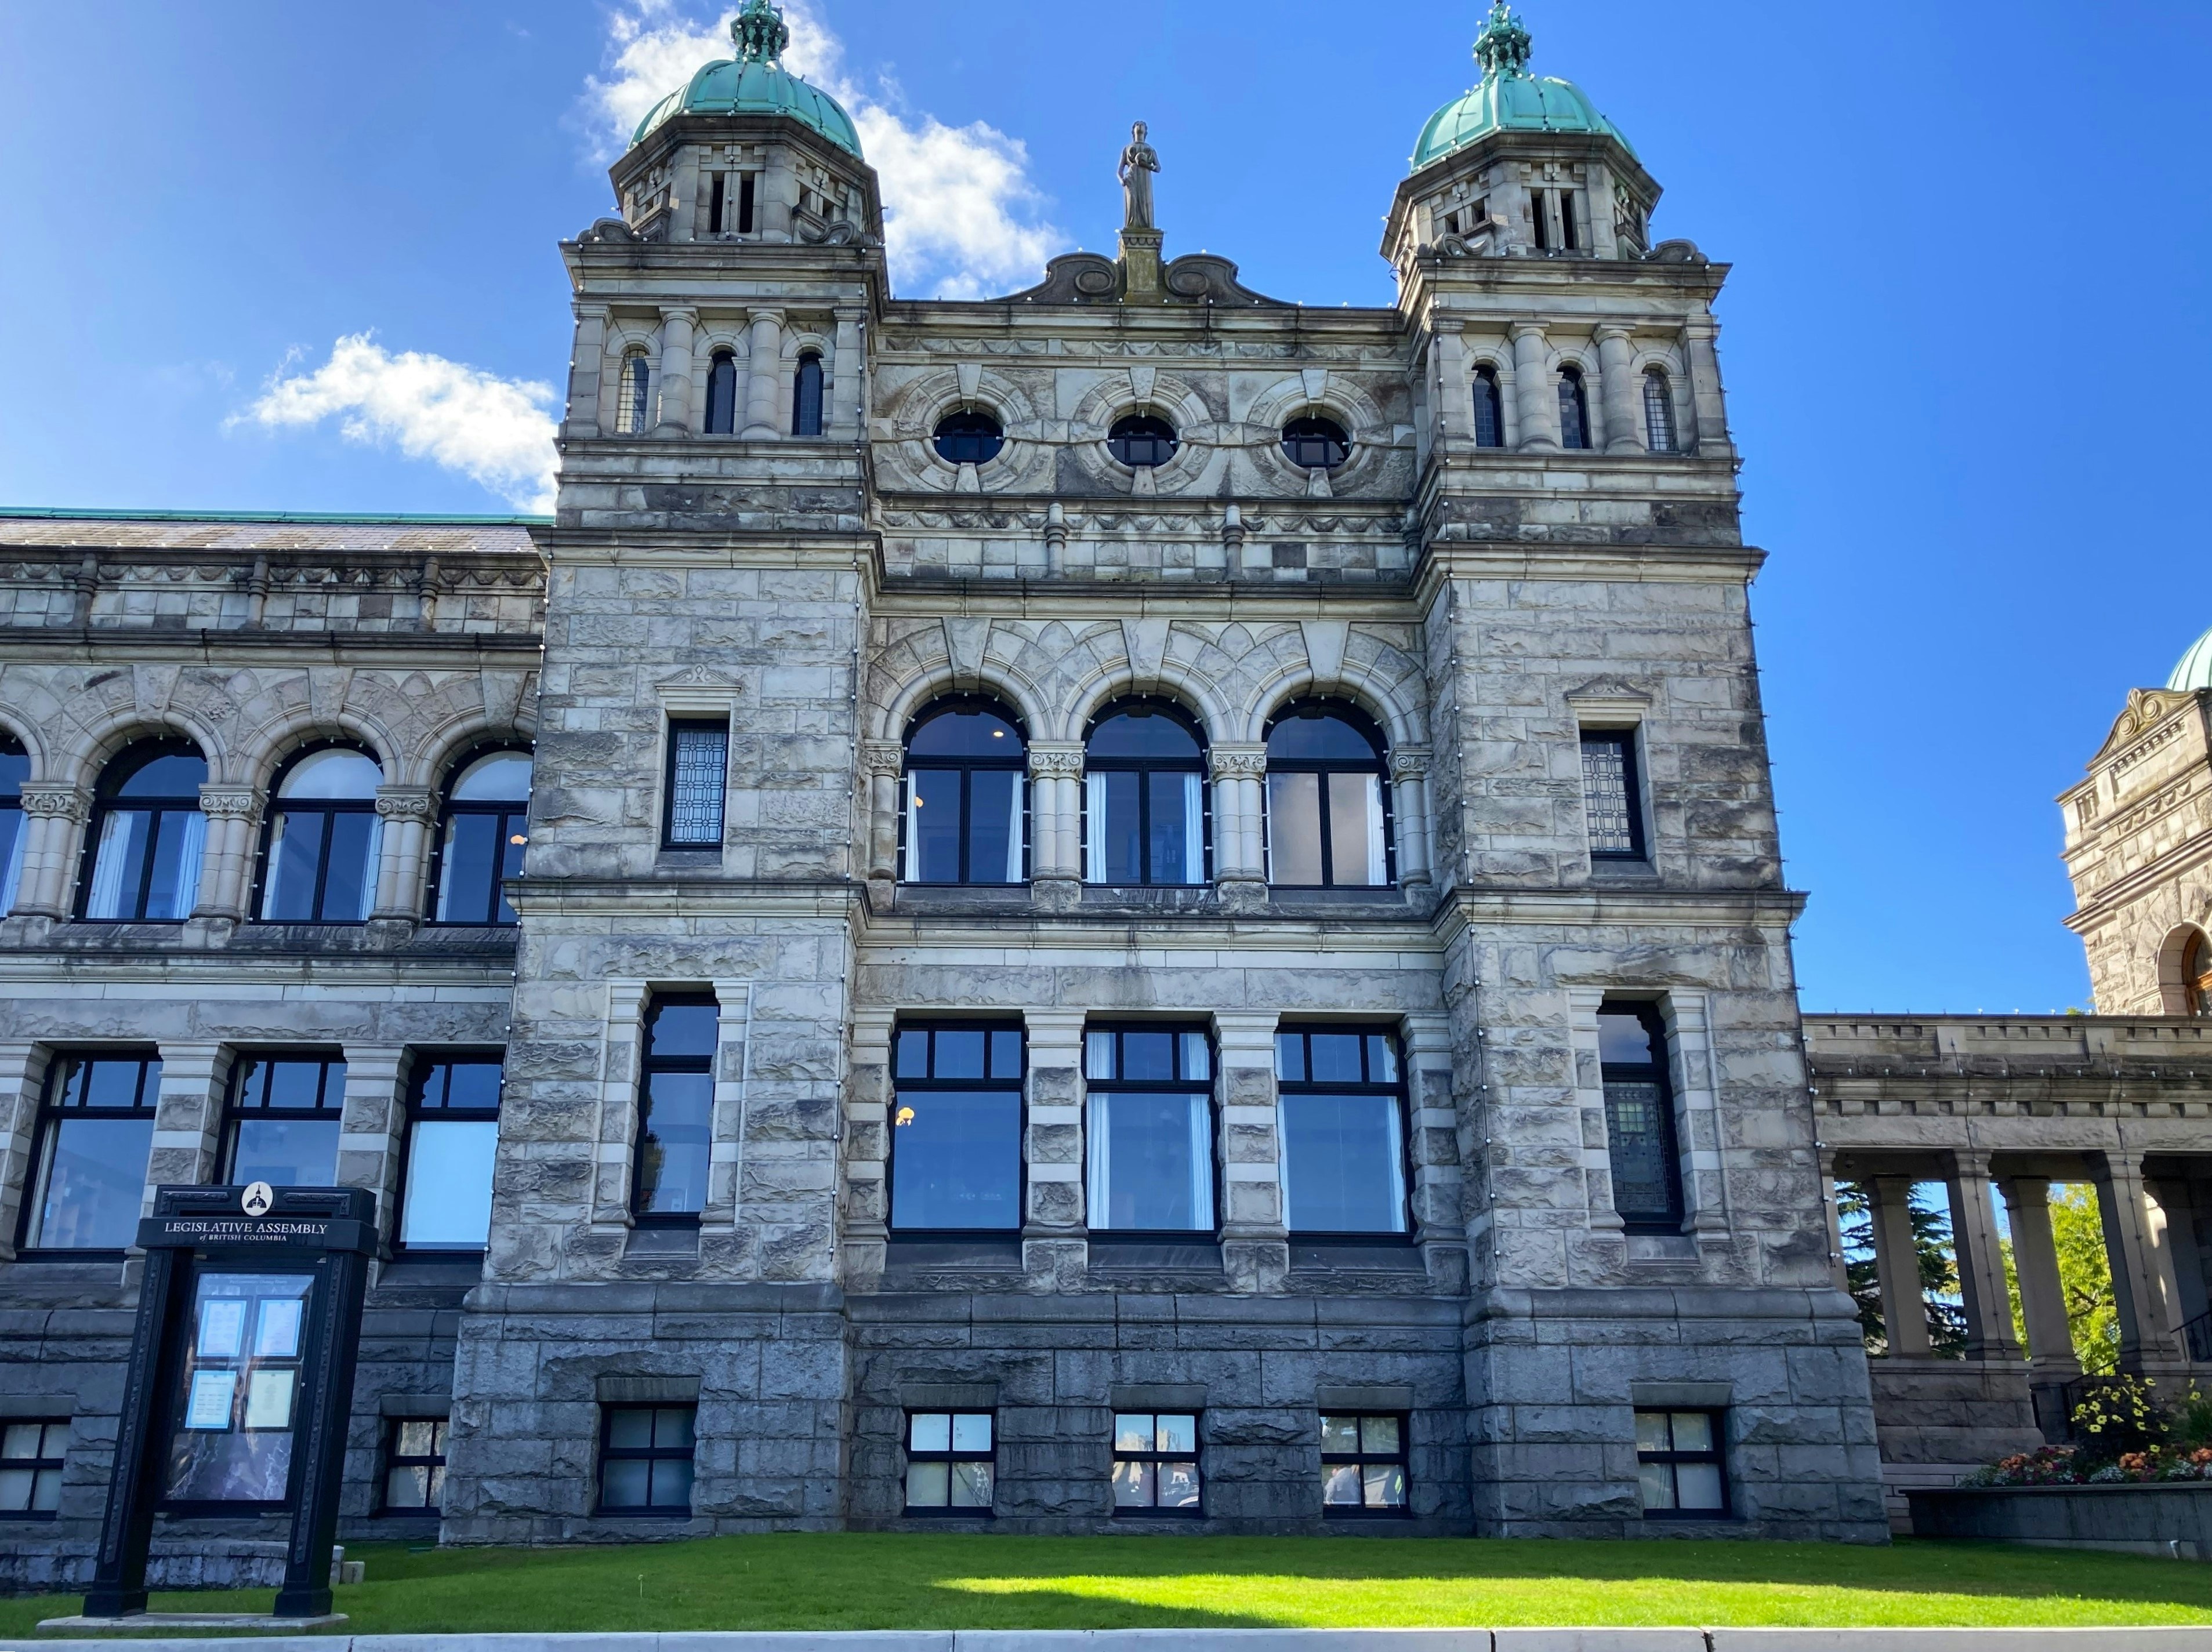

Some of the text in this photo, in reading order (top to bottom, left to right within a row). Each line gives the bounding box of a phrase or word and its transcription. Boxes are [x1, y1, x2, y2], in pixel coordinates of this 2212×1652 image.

[165, 1222, 328, 1234] LEGISLATIVE ASSEMBLY
[199, 1233, 208, 1241] of
